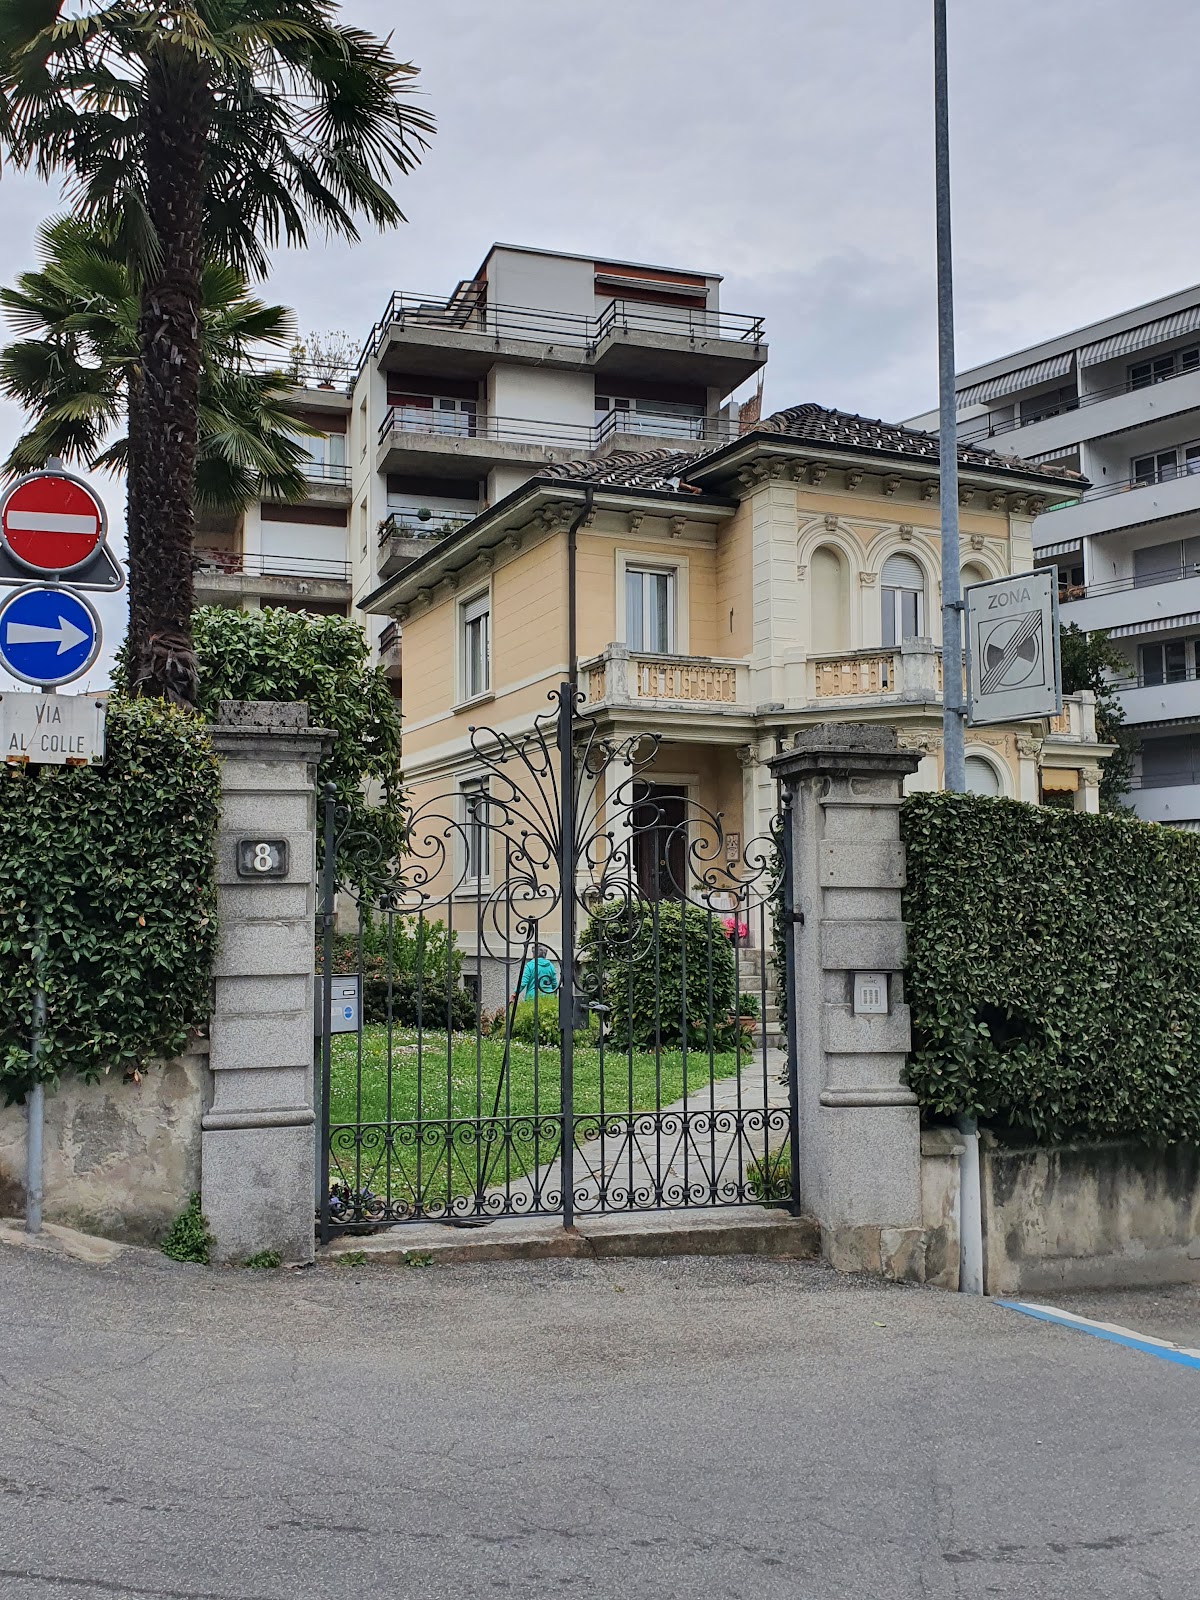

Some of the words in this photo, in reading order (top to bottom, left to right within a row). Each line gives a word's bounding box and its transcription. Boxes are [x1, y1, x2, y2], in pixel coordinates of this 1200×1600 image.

[988, 588, 1031, 610] ZONA
[35, 705, 61, 724] VIA
[9, 733, 27, 751] AL
[41, 734, 85, 753] COLLE
[254, 843, 273, 872] 8
